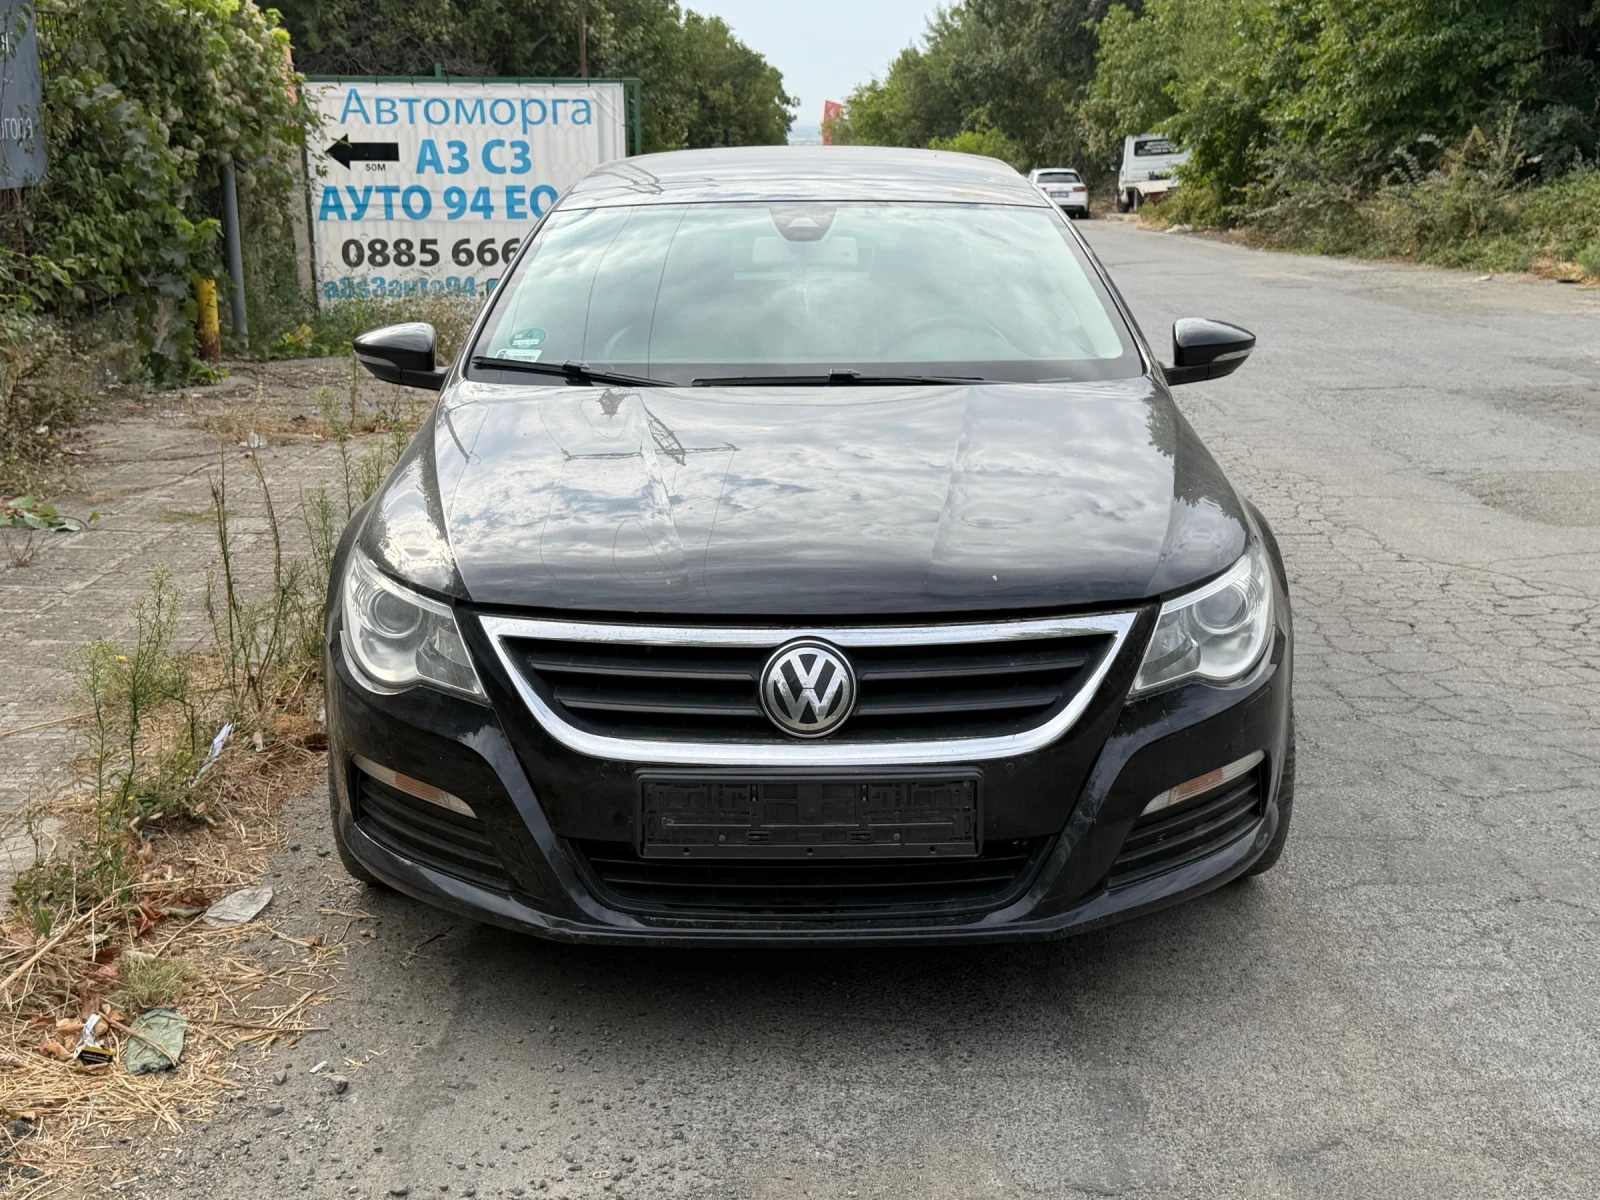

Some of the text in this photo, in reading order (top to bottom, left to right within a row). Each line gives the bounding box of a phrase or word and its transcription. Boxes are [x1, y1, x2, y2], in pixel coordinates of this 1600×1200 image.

[340, 88, 592, 135] Автоморга
[318, 185, 432, 221] АУТО
[443, 186, 495, 220] 94
[341, 238, 440, 267] 0885
[766, 647, 850, 731] VW
